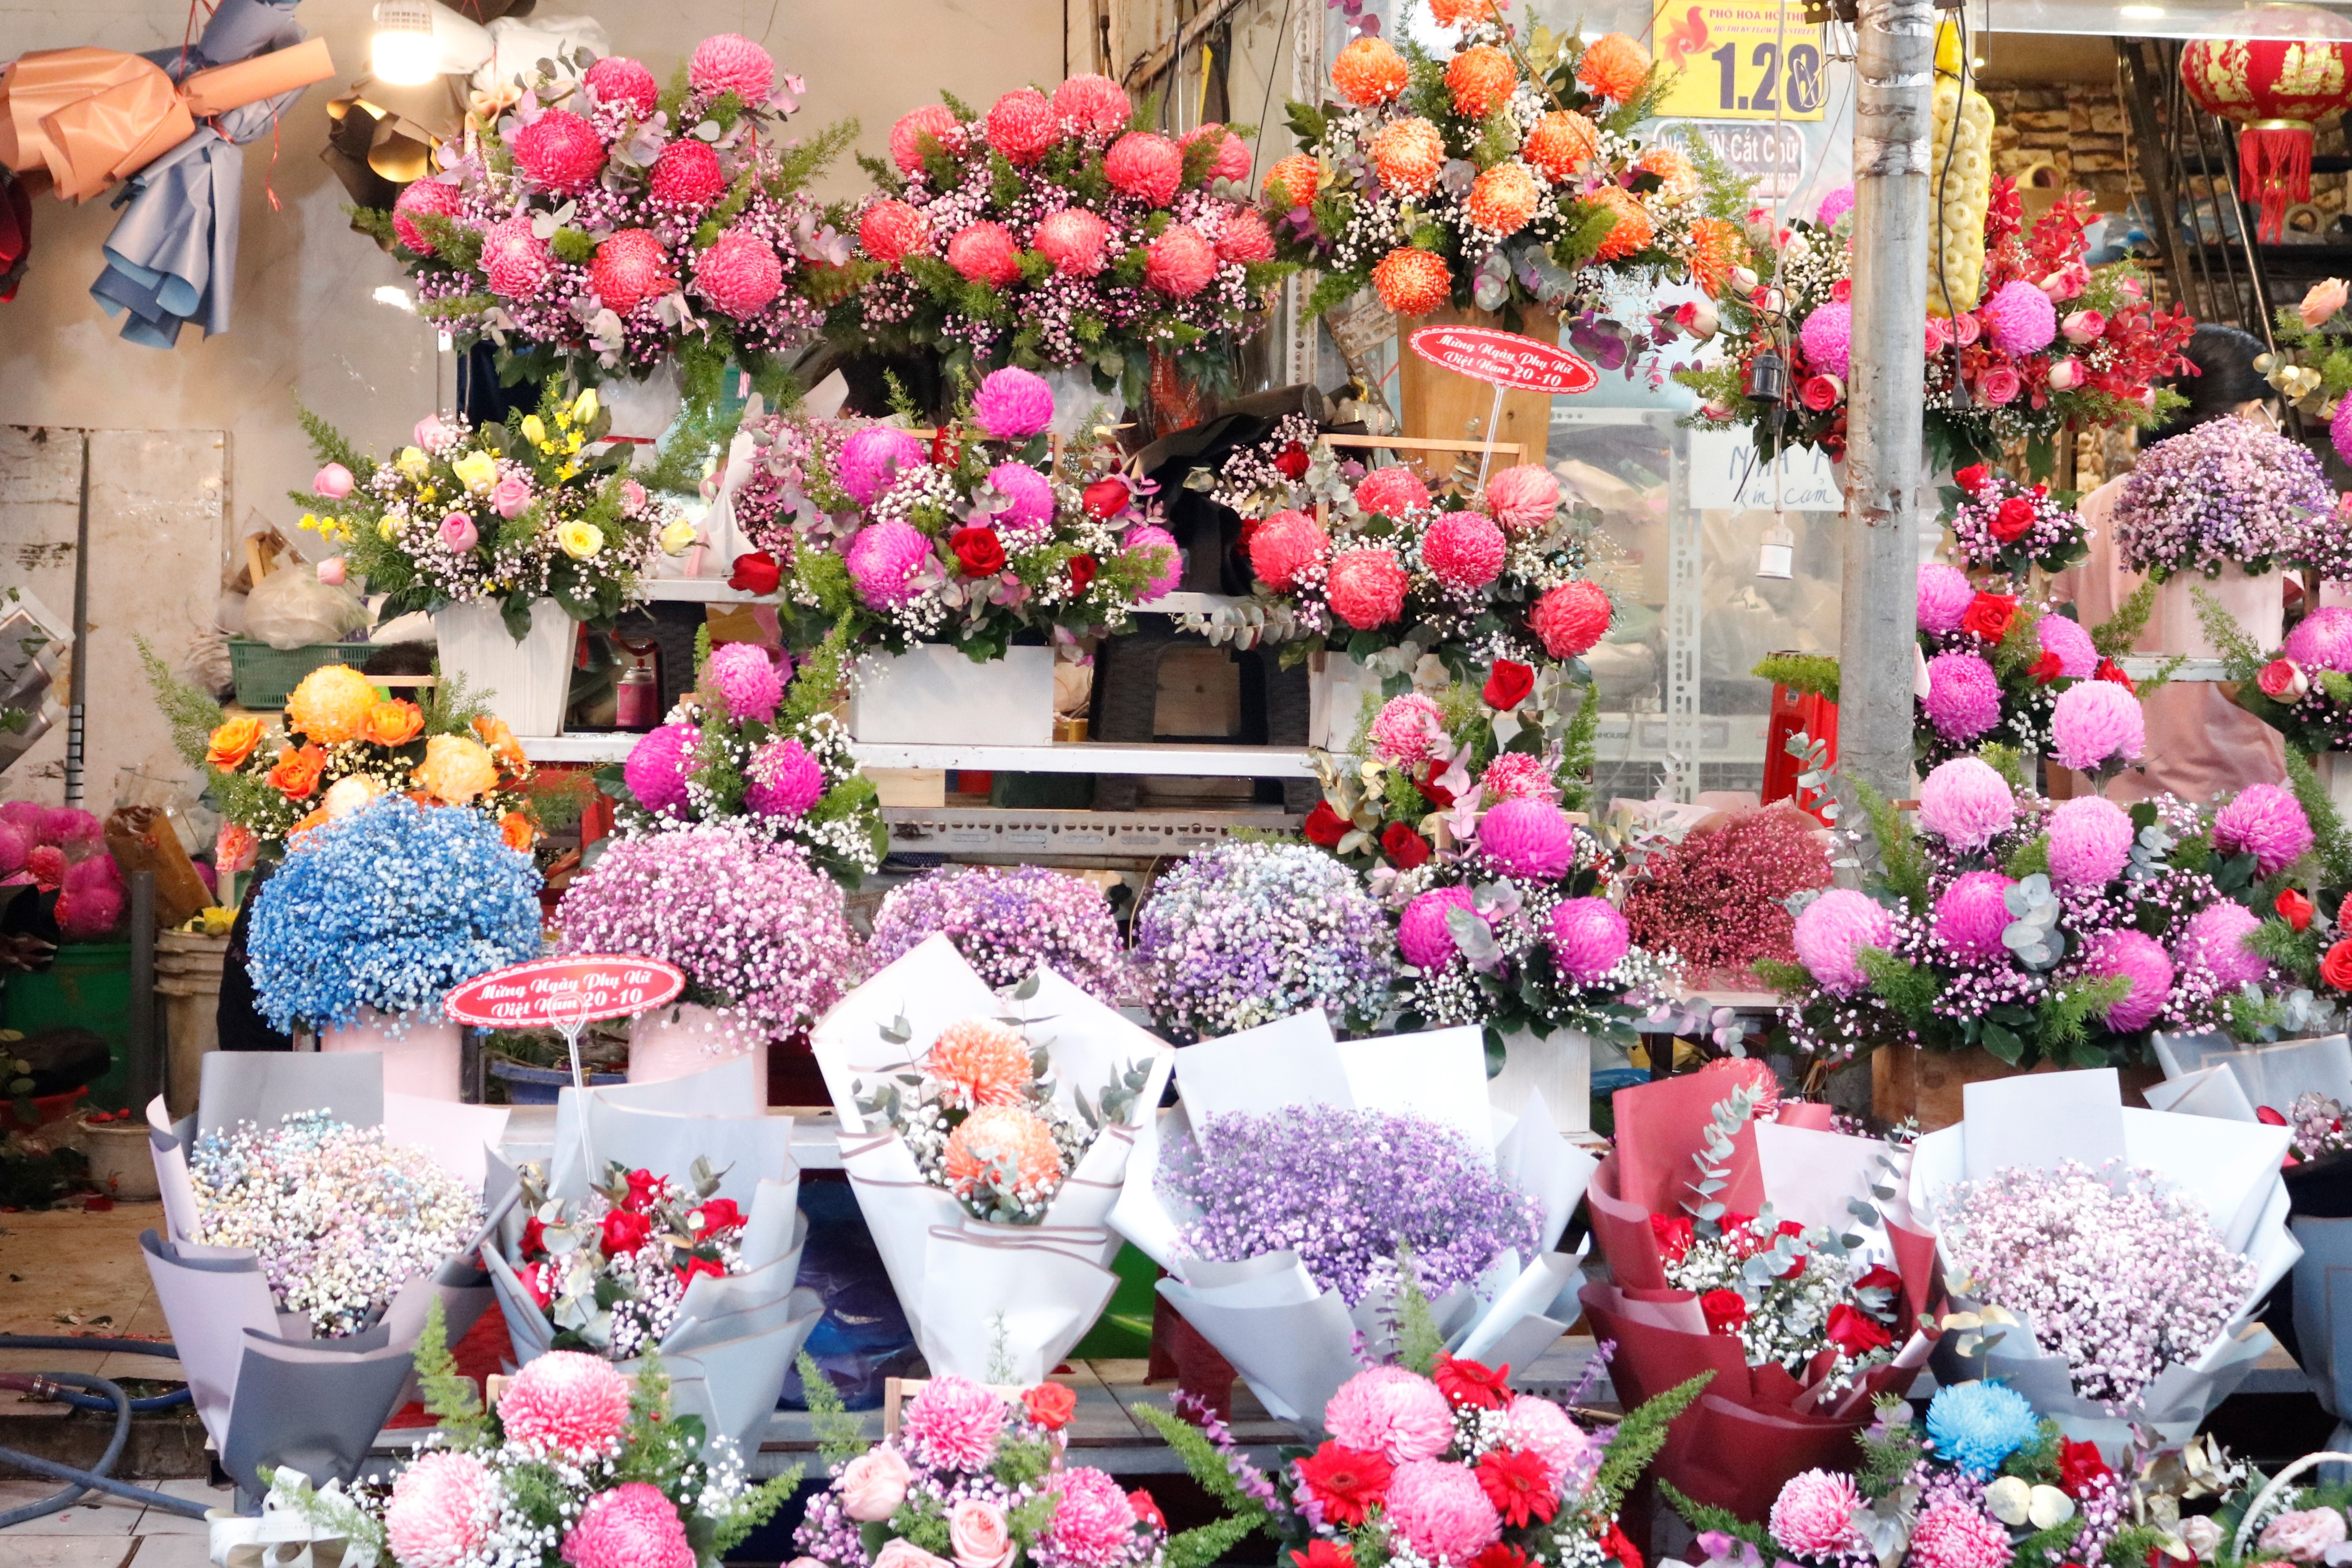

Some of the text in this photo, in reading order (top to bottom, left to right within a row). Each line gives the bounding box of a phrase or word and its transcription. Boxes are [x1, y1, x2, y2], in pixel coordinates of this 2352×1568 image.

[1709, 7, 1733, 18] PHỐ
[1737, 10, 1761, 20] HOA
[1712, 42, 1819, 113] 1.28
[1731, 128, 1758, 162] Cắt
[1436, 334, 1574, 374] Mừng Ngày Phụ Nữ
[1443, 351, 1474, 368] Việt
[1477, 358, 1510, 375] Nam
[476, 969, 652, 1001] Mừng Ngày Phụ Nữ
[491, 1001, 530, 1019] Việt
[534, 997, 578, 1012] Nam
